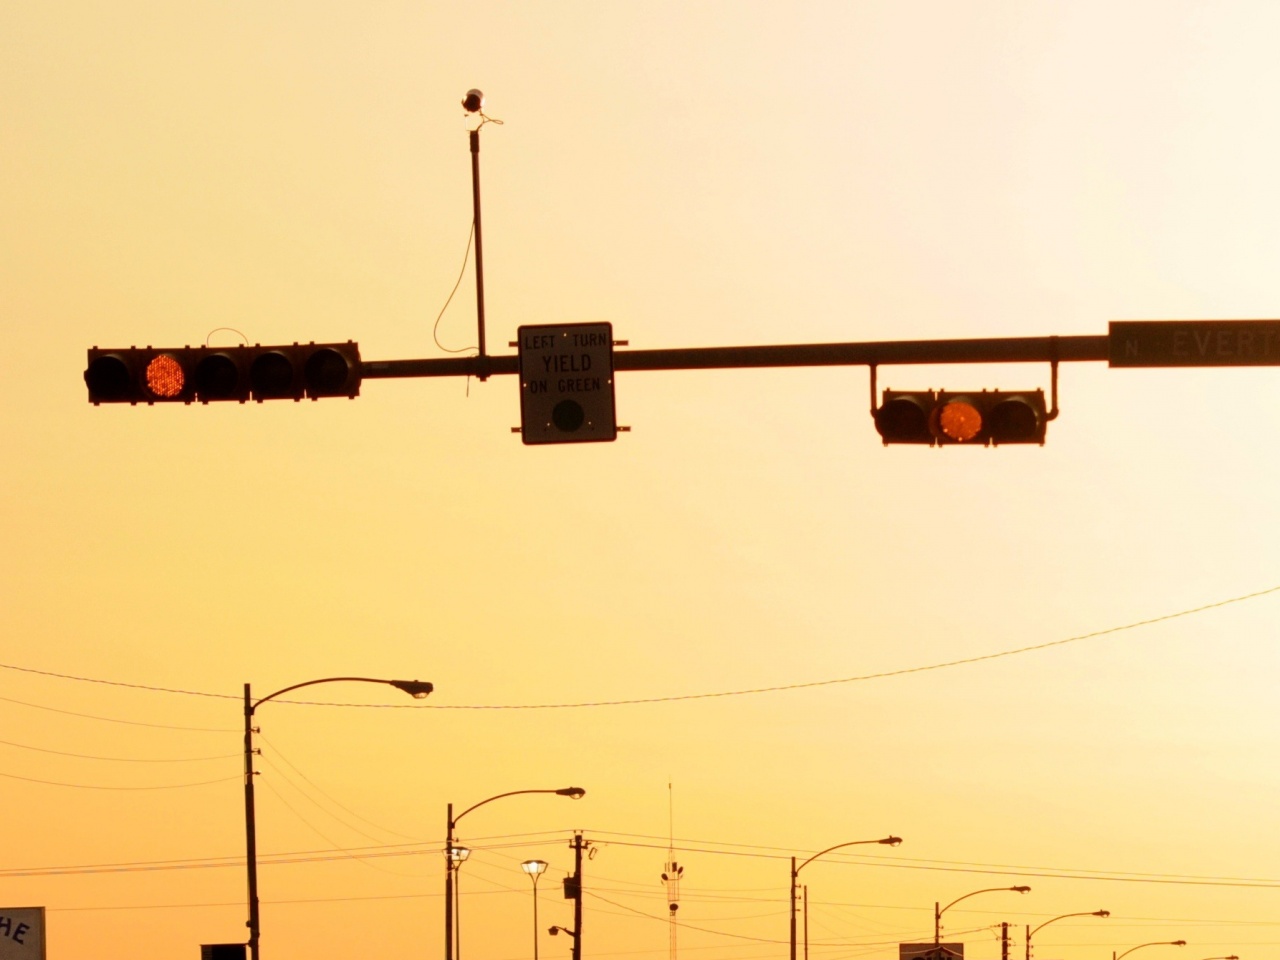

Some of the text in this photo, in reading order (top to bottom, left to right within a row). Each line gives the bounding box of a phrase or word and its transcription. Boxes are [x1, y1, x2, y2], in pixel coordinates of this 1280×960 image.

[525, 333, 607, 350] LEFT TURN
[542, 354, 592, 373] YIELD
[530, 378, 600, 394] ON GREEN
